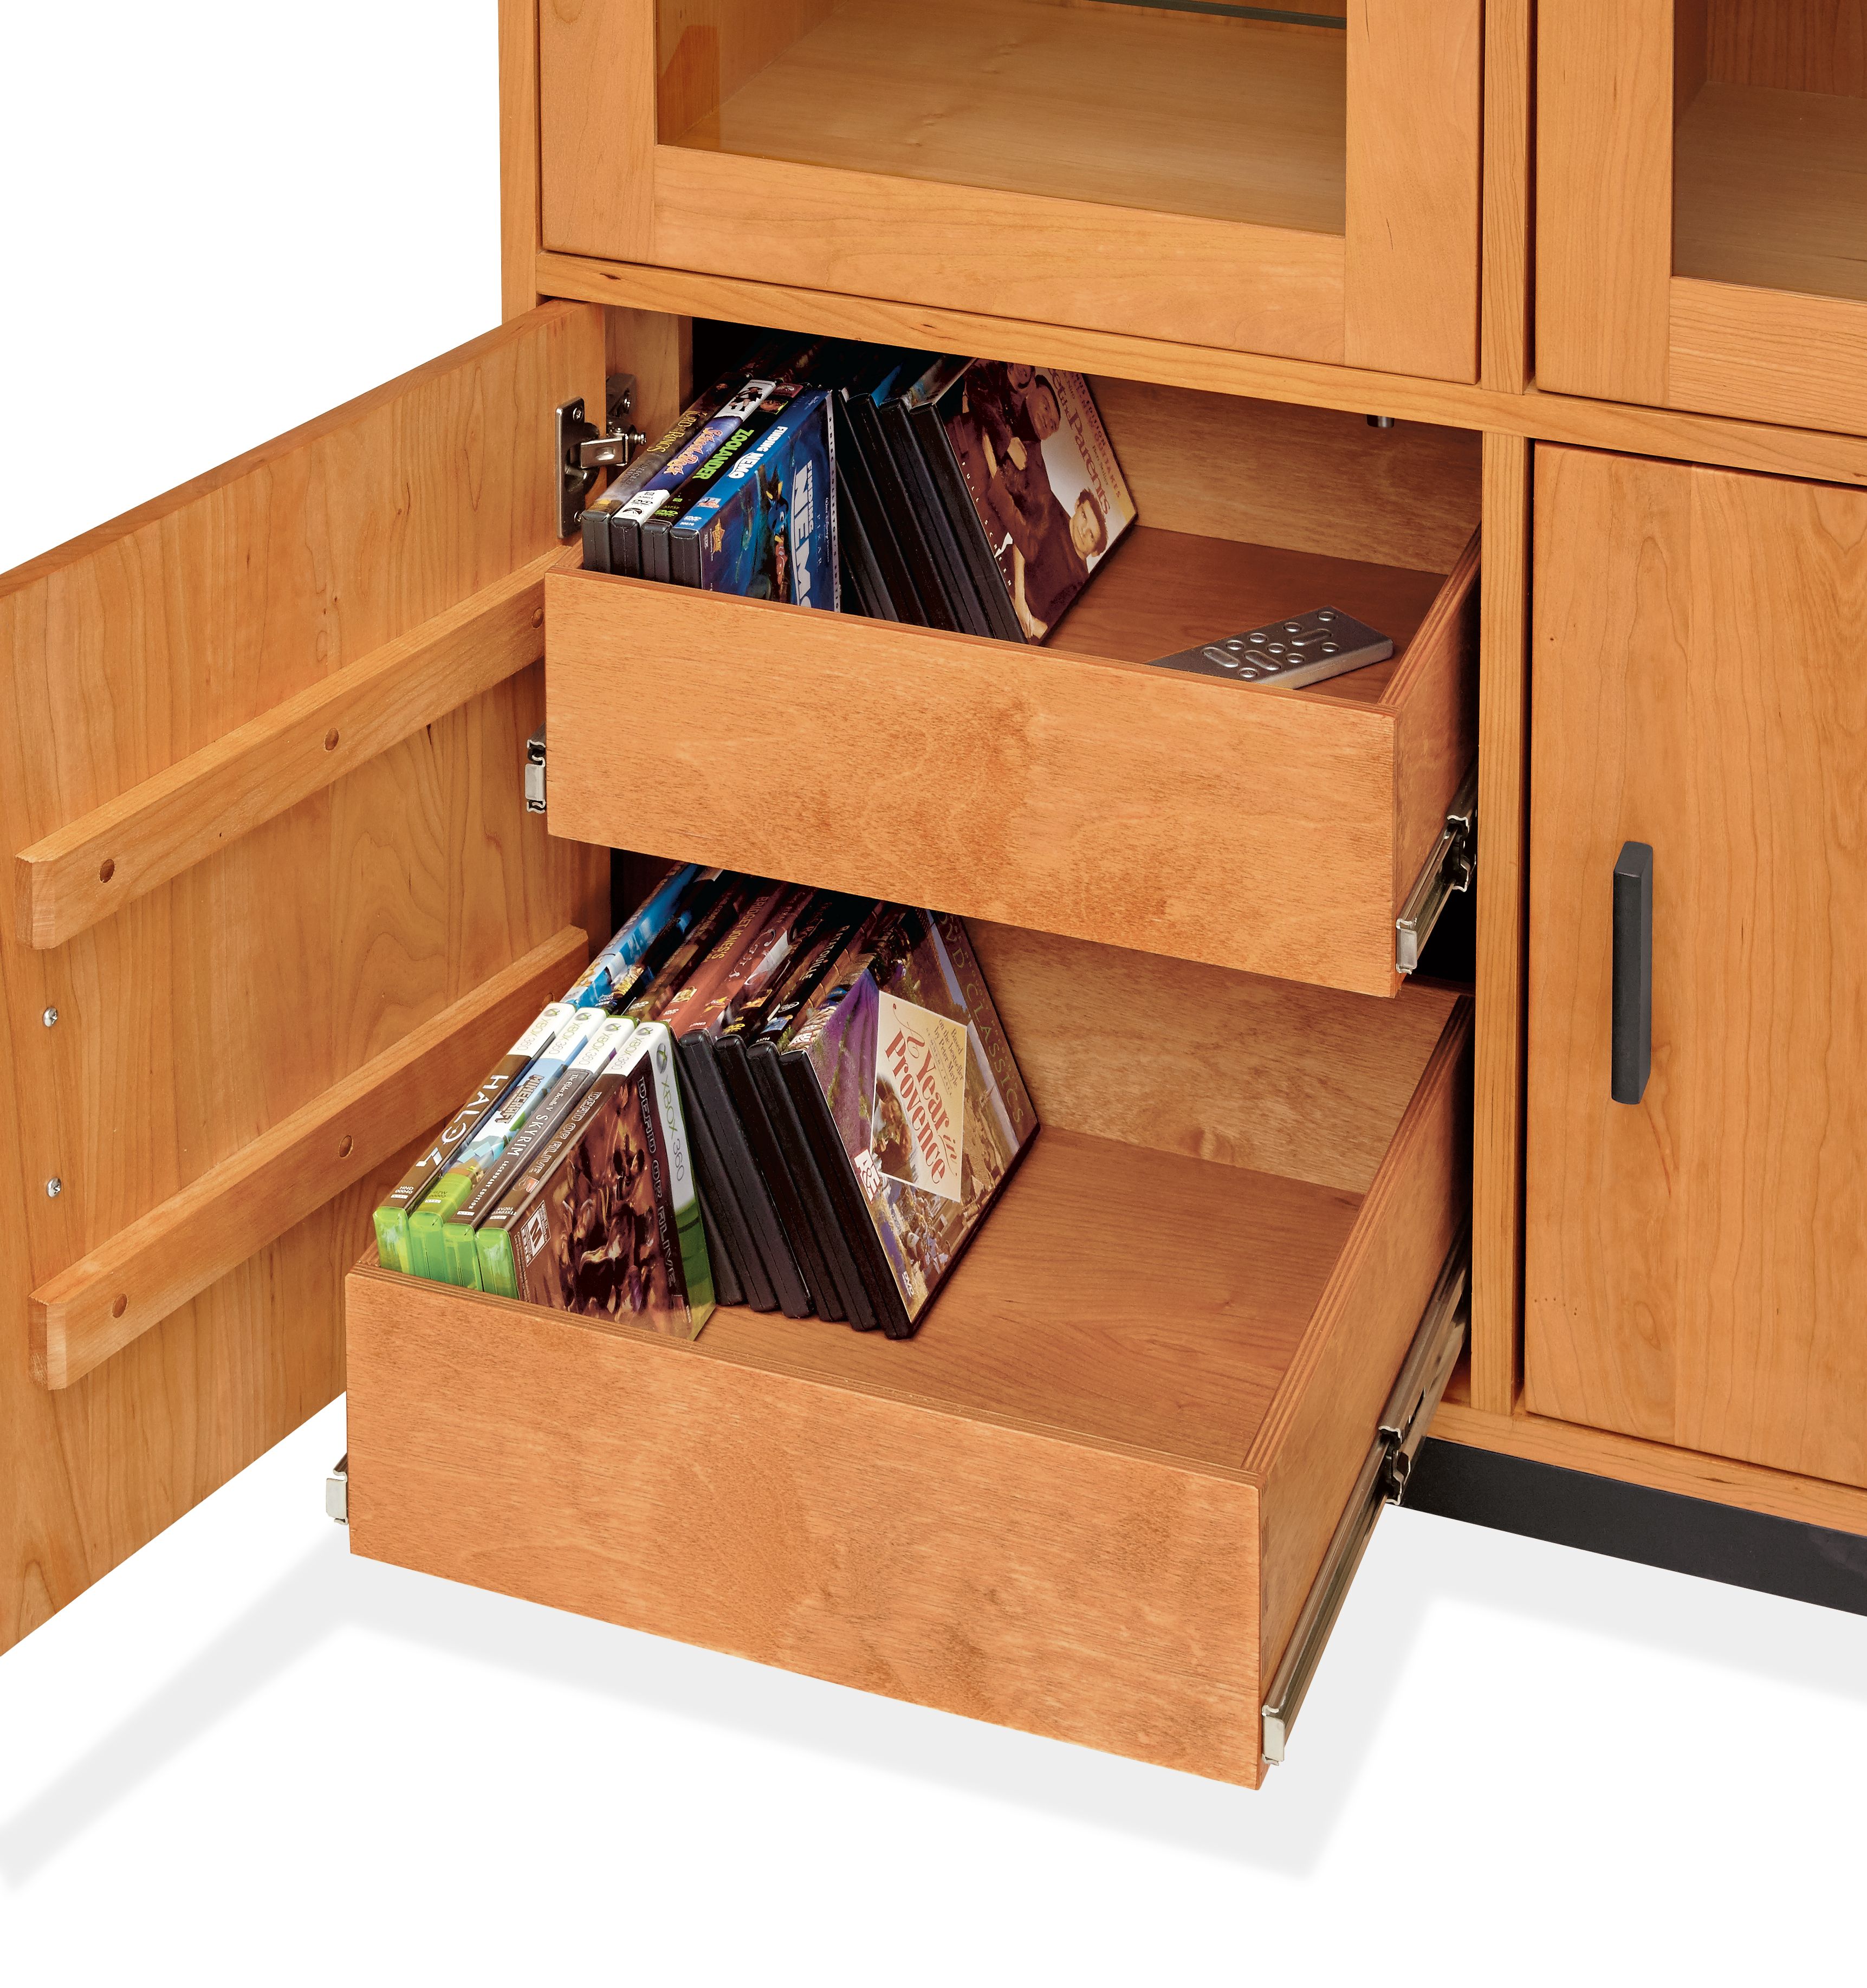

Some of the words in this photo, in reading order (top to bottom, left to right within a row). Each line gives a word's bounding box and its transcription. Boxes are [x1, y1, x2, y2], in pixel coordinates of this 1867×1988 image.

[678, 410, 706, 431] LORD
[646, 431, 685, 453] RINGS
[691, 427, 723, 455] School
[756, 426, 788, 453] FINDING
[663, 454, 699, 476] Rock
[692, 428, 755, 480] ZOOLANDER
[728, 452, 764, 479] NEMO
[1069, 407, 1111, 515] Parents
[961, 462, 980, 503] FULL
[984, 520, 1012, 586] SCREEN
[739, 896, 769, 928] BRIDGET
[712, 929, 744, 959] JONES'S
[728, 928, 776, 979] Cars
[800, 925, 850, 981] RATATOUILLE
[531, 1019, 549, 1037] XBOX
[562, 1023, 581, 1041] XBOX
[951, 1028, 963, 1055] Based
[516, 1037, 535, 1051] 360
[549, 1040, 567, 1054] 360
[592, 1033, 612, 1052] XBOX
[623, 1037, 645, 1057] XBOX
[934, 1026, 940, 1040] by
[938, 1038, 949, 1062] Peter
[947, 1061, 958, 1087] Mayle
[939, 1019, 944, 1030] on
[948, 1041, 964, 1080] bestseller
[967, 983, 1023, 1123] CLASSICS
[579, 1052, 597, 1065] 360
[612, 1057, 629, 1071] 360
[495, 1074, 545, 1124] MINECRAFT
[548, 1092, 564, 1106] Scrolls
[559, 1082, 573, 1093] Elder
[916, 1049, 949, 1133] Year
[441, 1074, 509, 1144] HALO
[572, 1091, 602, 1122] DEAD
[884, 1028, 945, 1184] Provence
[507, 1113, 548, 1157] SKYRIM
[555, 1123, 577, 1140] OR
[661, 1074, 678, 1141] XBOX
[672, 1138, 685, 1182] 360
[415, 1147, 443, 1167] 4
[528, 1141, 563, 1175] ALIVE
[485, 1160, 509, 1188] LEGENDARY
[638, 1076, 657, 1154] DEAD
[652, 1159, 663, 1199] OR
[658, 1205, 677, 1287] ALIVE
[854, 1149, 880, 1204] A&E
[468, 1188, 487, 1209] EDITION
[530, 1218, 543, 1249] M
[902, 1271, 914, 1297] DVD
